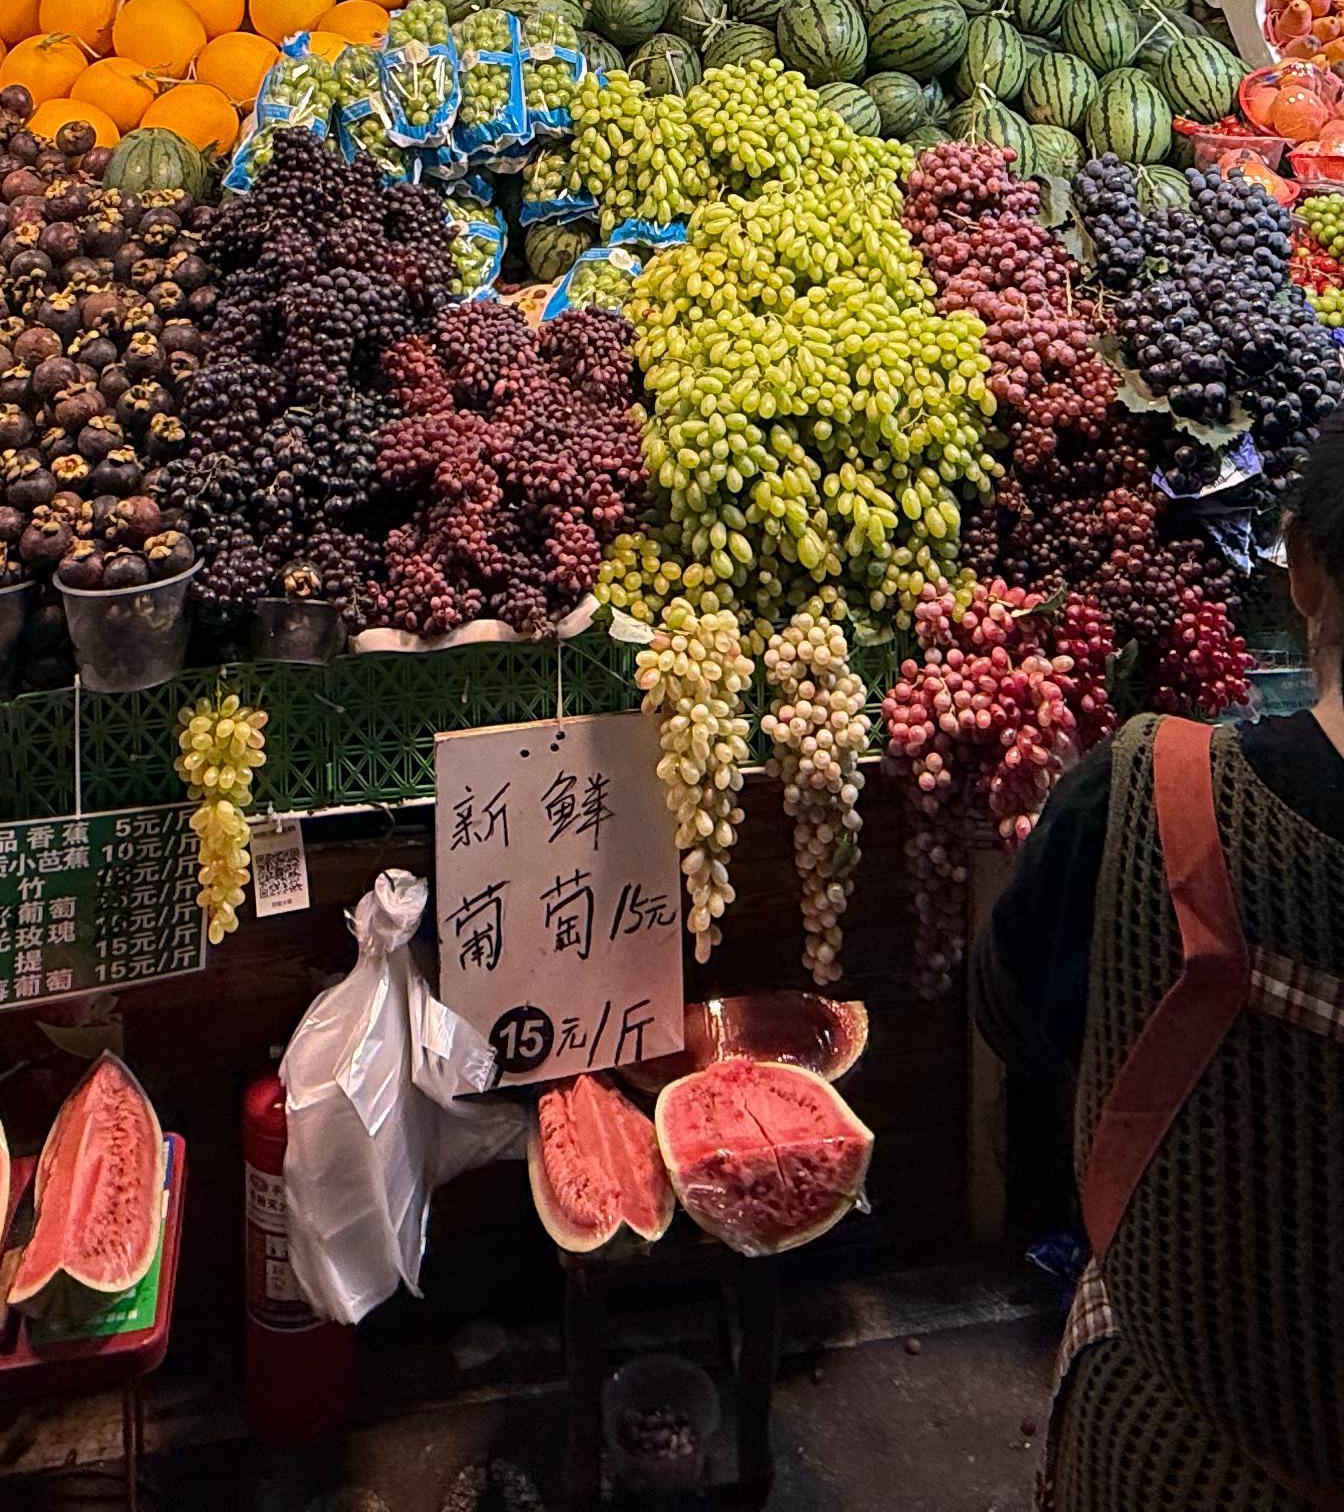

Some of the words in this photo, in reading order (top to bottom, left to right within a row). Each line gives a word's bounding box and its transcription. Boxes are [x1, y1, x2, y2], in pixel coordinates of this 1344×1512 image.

[450, 770, 614, 851] 新鲜
[96, 924, 198, 958] 15元/斤
[443, 868, 594, 971] 葡萄
[609, 881, 677, 941] 15元
[95, 945, 197, 982] 15元/斤
